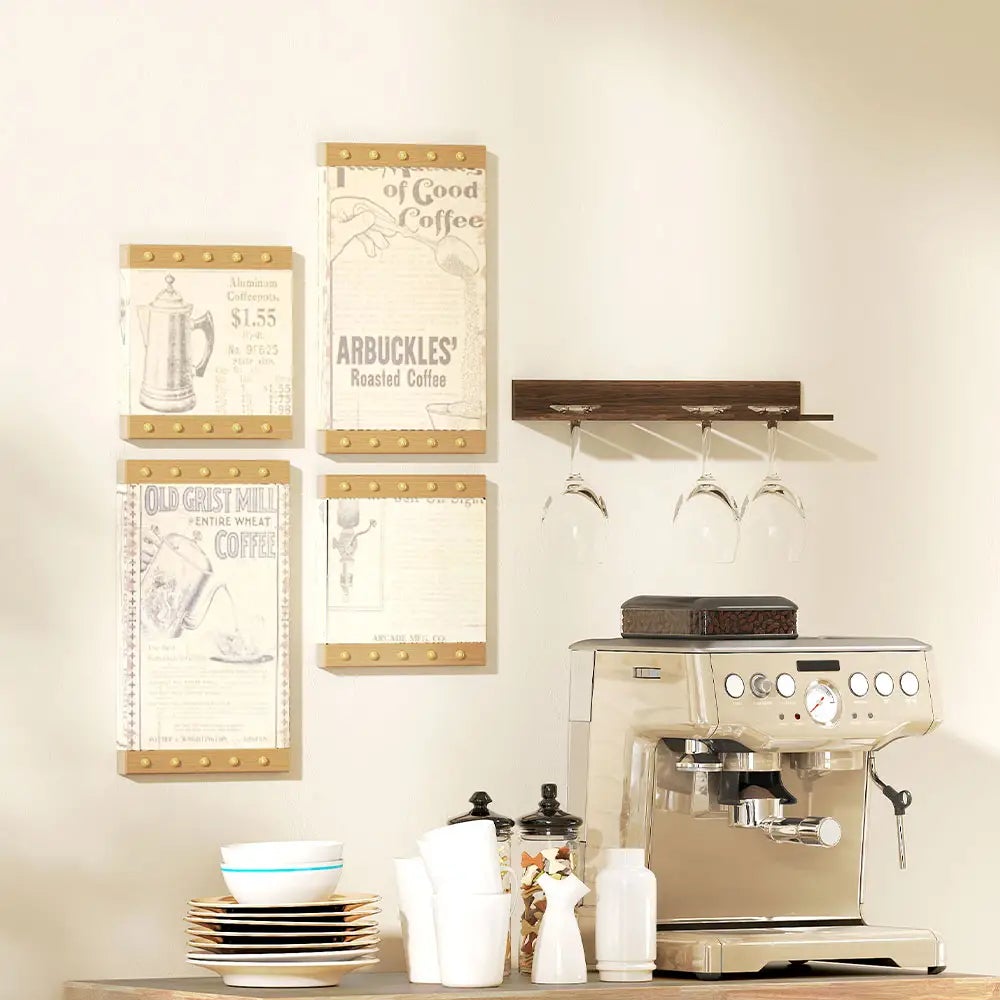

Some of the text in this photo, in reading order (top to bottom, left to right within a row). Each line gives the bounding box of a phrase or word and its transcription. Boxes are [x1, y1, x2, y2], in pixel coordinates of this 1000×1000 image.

[384, 178, 478, 206] of Good
[399, 207, 484, 236] Coffee
[229, 277, 278, 289] Aluminum
[231, 307, 277, 329] $1.55
[336, 335, 458, 366] ARBUCKLES'
[350, 368, 447, 388] Roasted Coffee
[144, 485, 278, 516] OLD GRIST MILL
[195, 516, 272, 527] ENTIRE WHEAT
[214, 530, 276, 560] COFFEE
